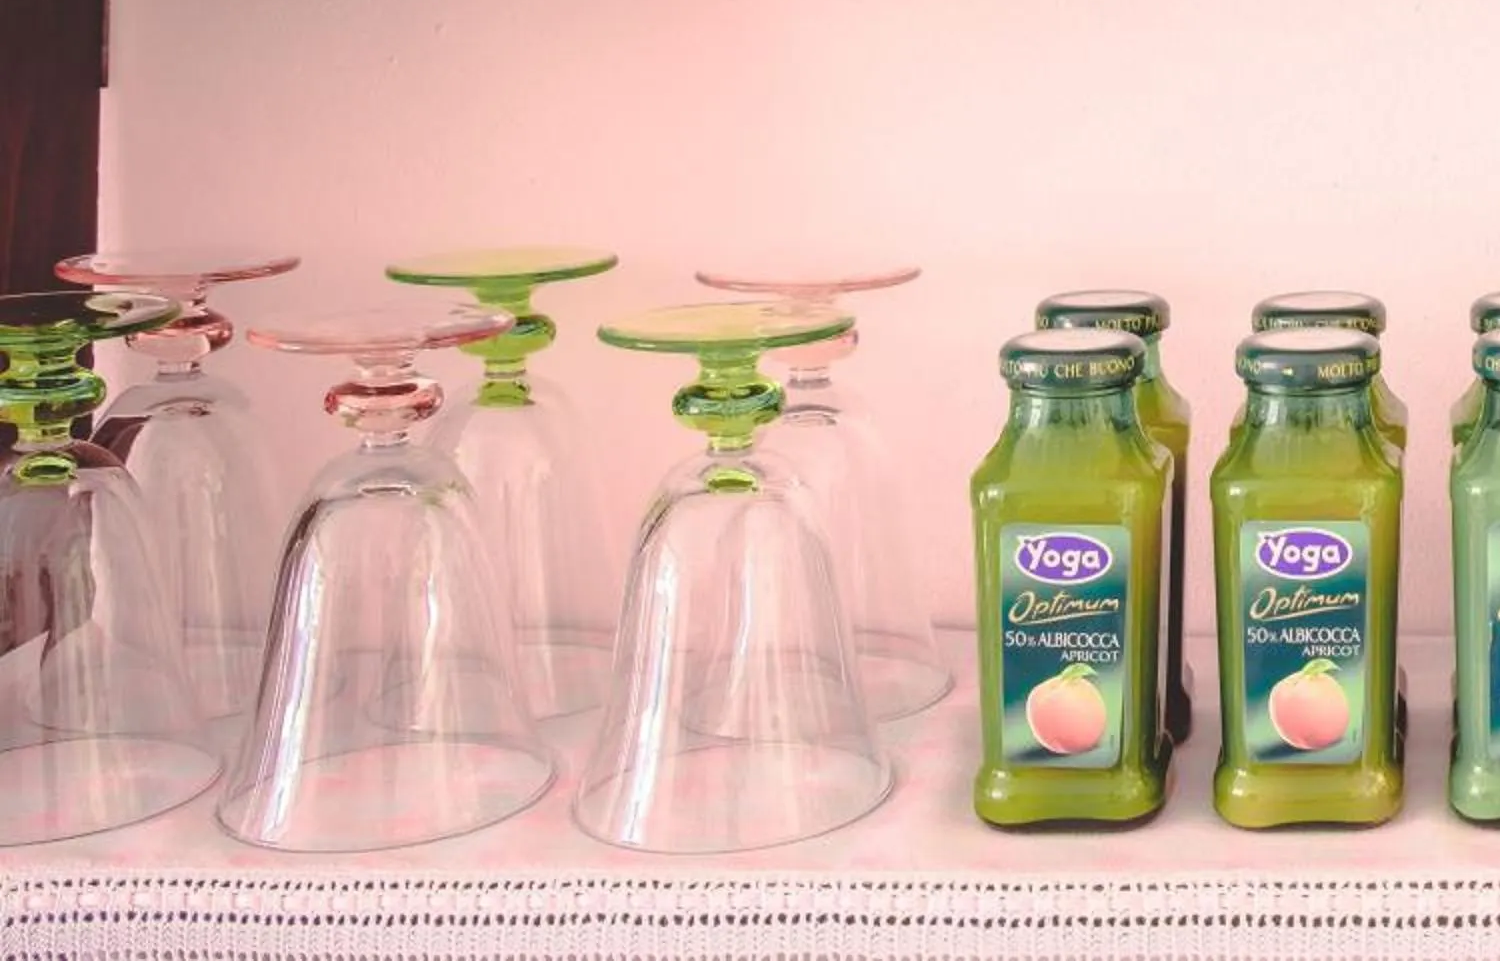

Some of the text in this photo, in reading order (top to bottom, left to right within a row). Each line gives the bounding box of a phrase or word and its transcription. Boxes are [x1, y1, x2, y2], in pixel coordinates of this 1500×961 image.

[1019, 539, 1100, 576] Yoga
[1258, 535, 1341, 571] Yoga
[1008, 591, 1120, 623] Optimum
[1250, 586, 1360, 620] Optimum
[1038, 632, 1120, 648] ALBICOCCA
[1280, 627, 1361, 644] ALBICOCCA
[1060, 649, 1120, 662] APRICOT
[1301, 644, 1360, 657] APRICOT
